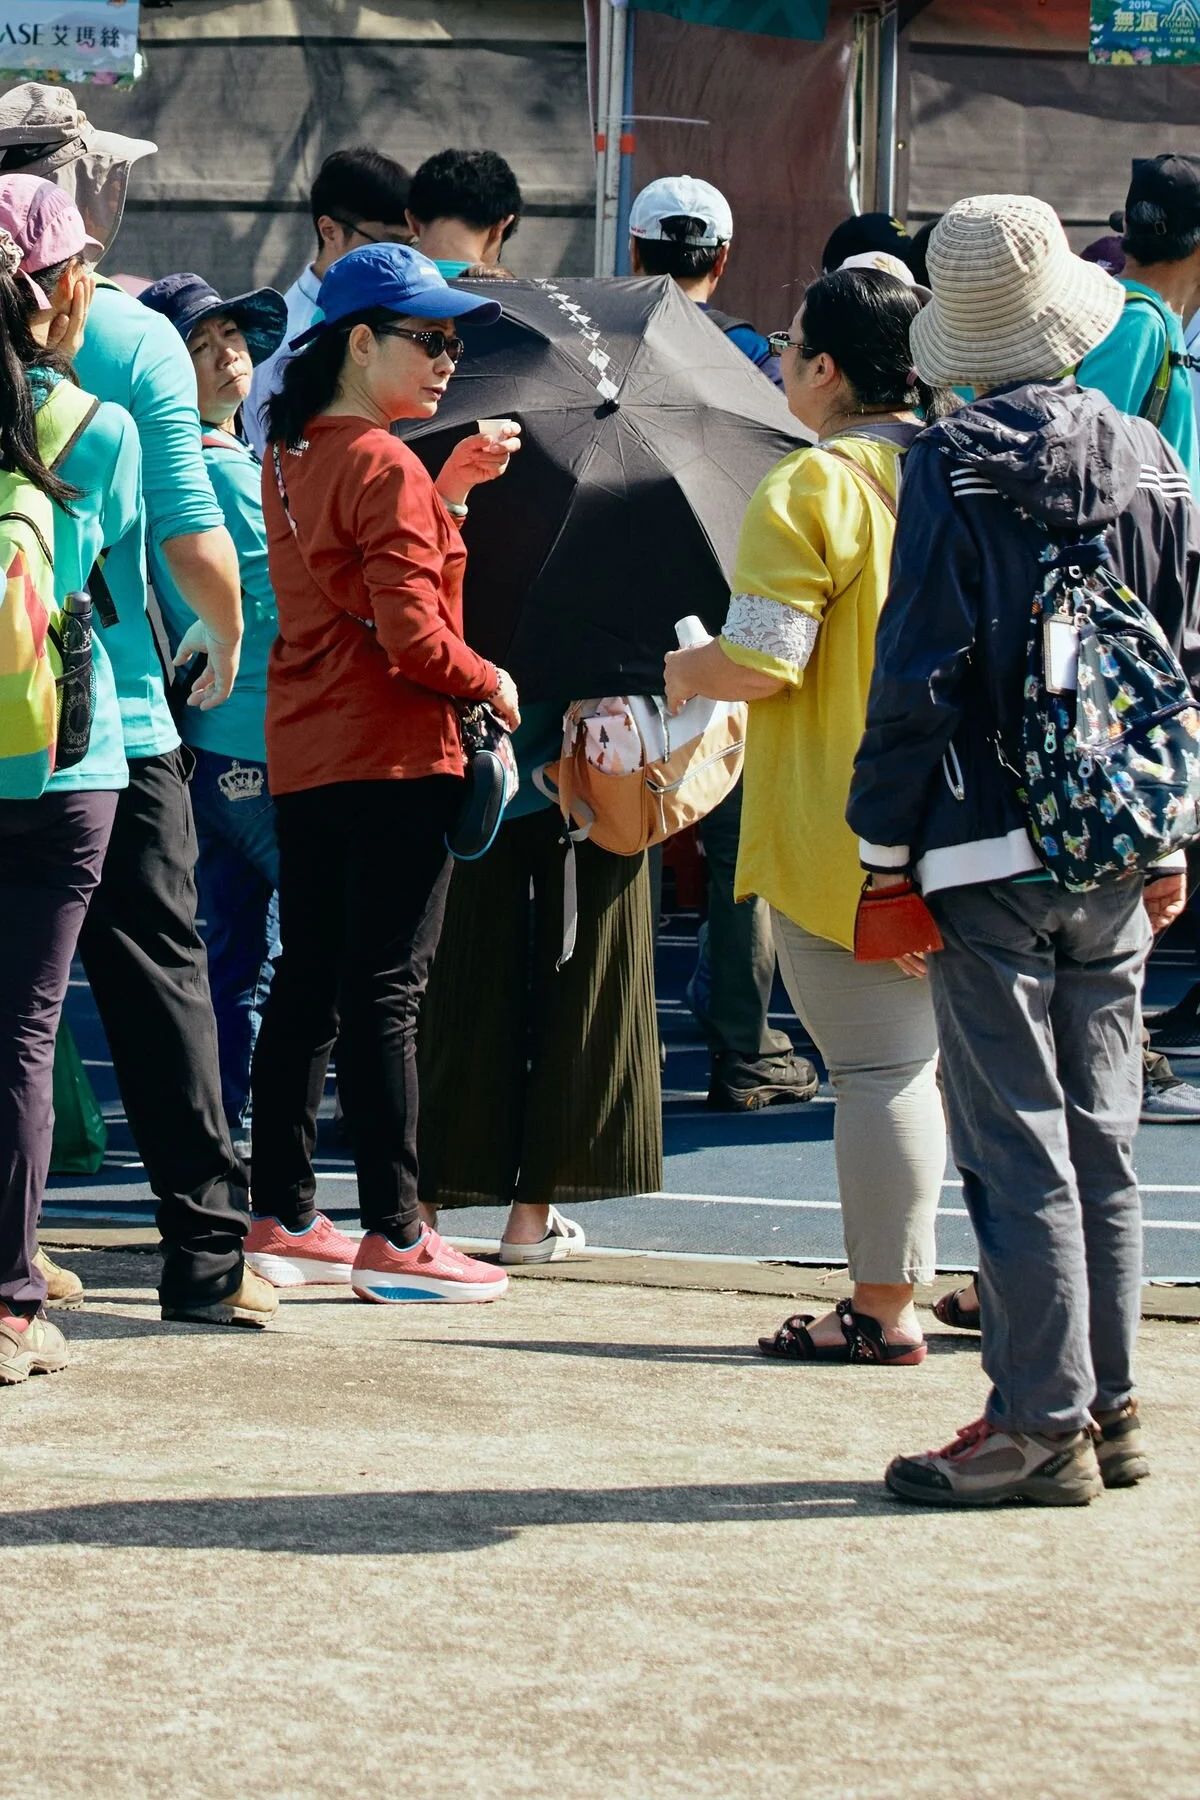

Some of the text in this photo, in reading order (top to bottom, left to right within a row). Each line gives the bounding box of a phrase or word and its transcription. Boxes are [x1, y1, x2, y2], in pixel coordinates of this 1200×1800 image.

[1129, 0, 1151, 10] 2019
[51, 24, 120, 48] 艾瑪絲
